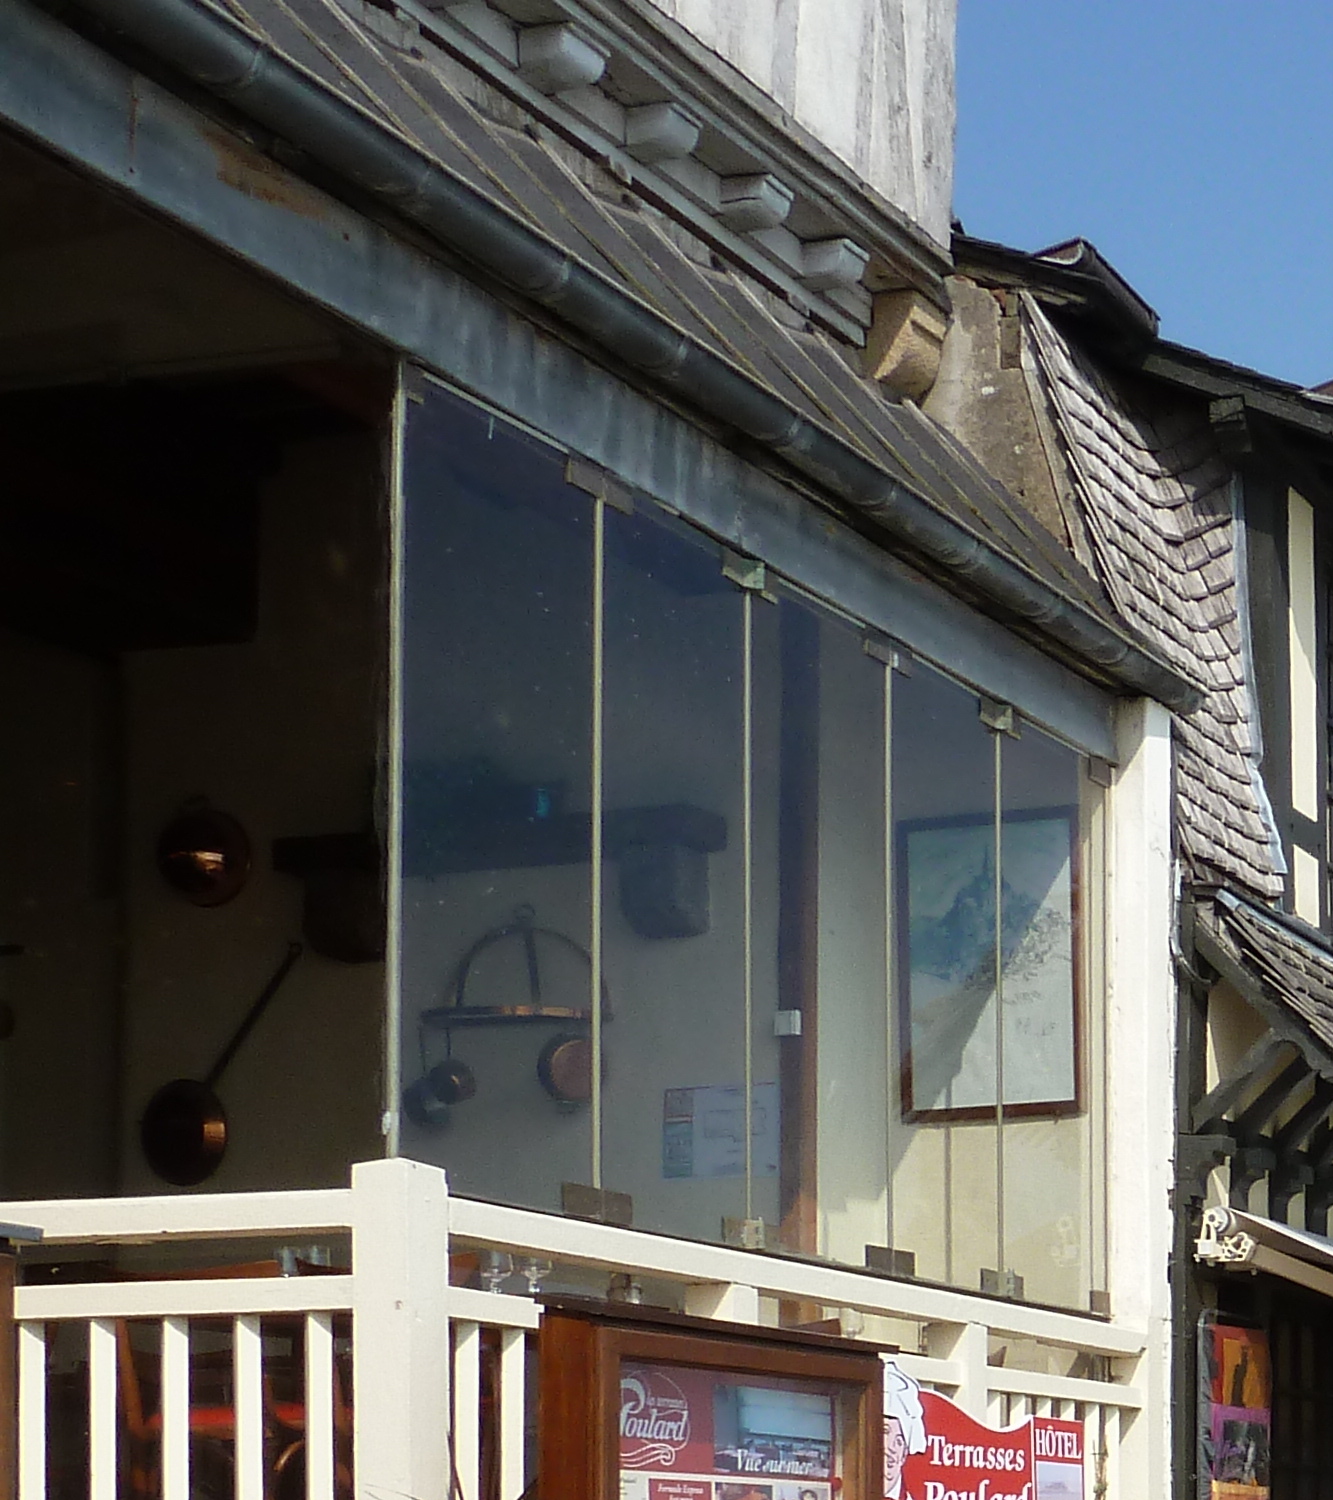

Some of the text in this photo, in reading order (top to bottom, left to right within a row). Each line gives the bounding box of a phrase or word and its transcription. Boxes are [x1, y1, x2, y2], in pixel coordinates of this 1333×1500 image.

[620, 1378, 689, 1442] Poulard
[928, 1435, 1025, 1472] Terrasses
[1035, 1425, 1082, 1459] HÔTEL
[737, 1448, 761, 1471] Vue
[786, 1461, 813, 1476] mer
